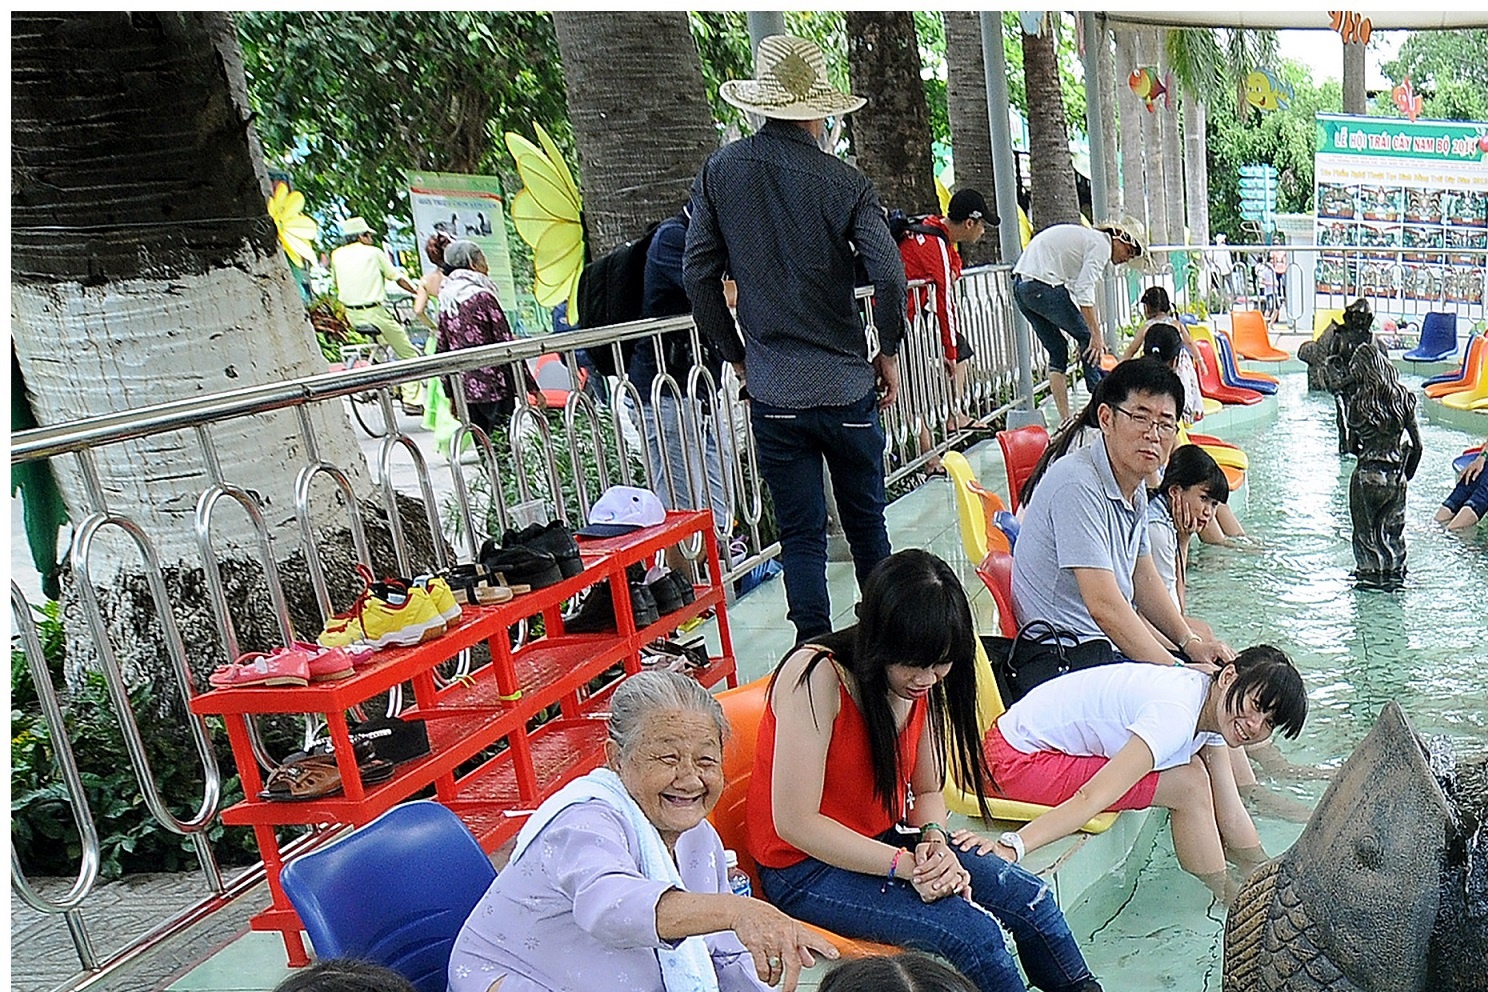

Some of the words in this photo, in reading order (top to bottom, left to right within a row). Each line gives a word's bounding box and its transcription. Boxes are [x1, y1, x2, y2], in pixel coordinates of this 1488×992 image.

[1349, 130, 1368, 152] HỘI
[1368, 131, 1392, 151] TRÁI
[1392, 132, 1413, 151] CÂY
[1413, 135, 1435, 153] NAM
[1436, 134, 1451, 156] BỘ
[1452, 137, 1477, 155] 2014
